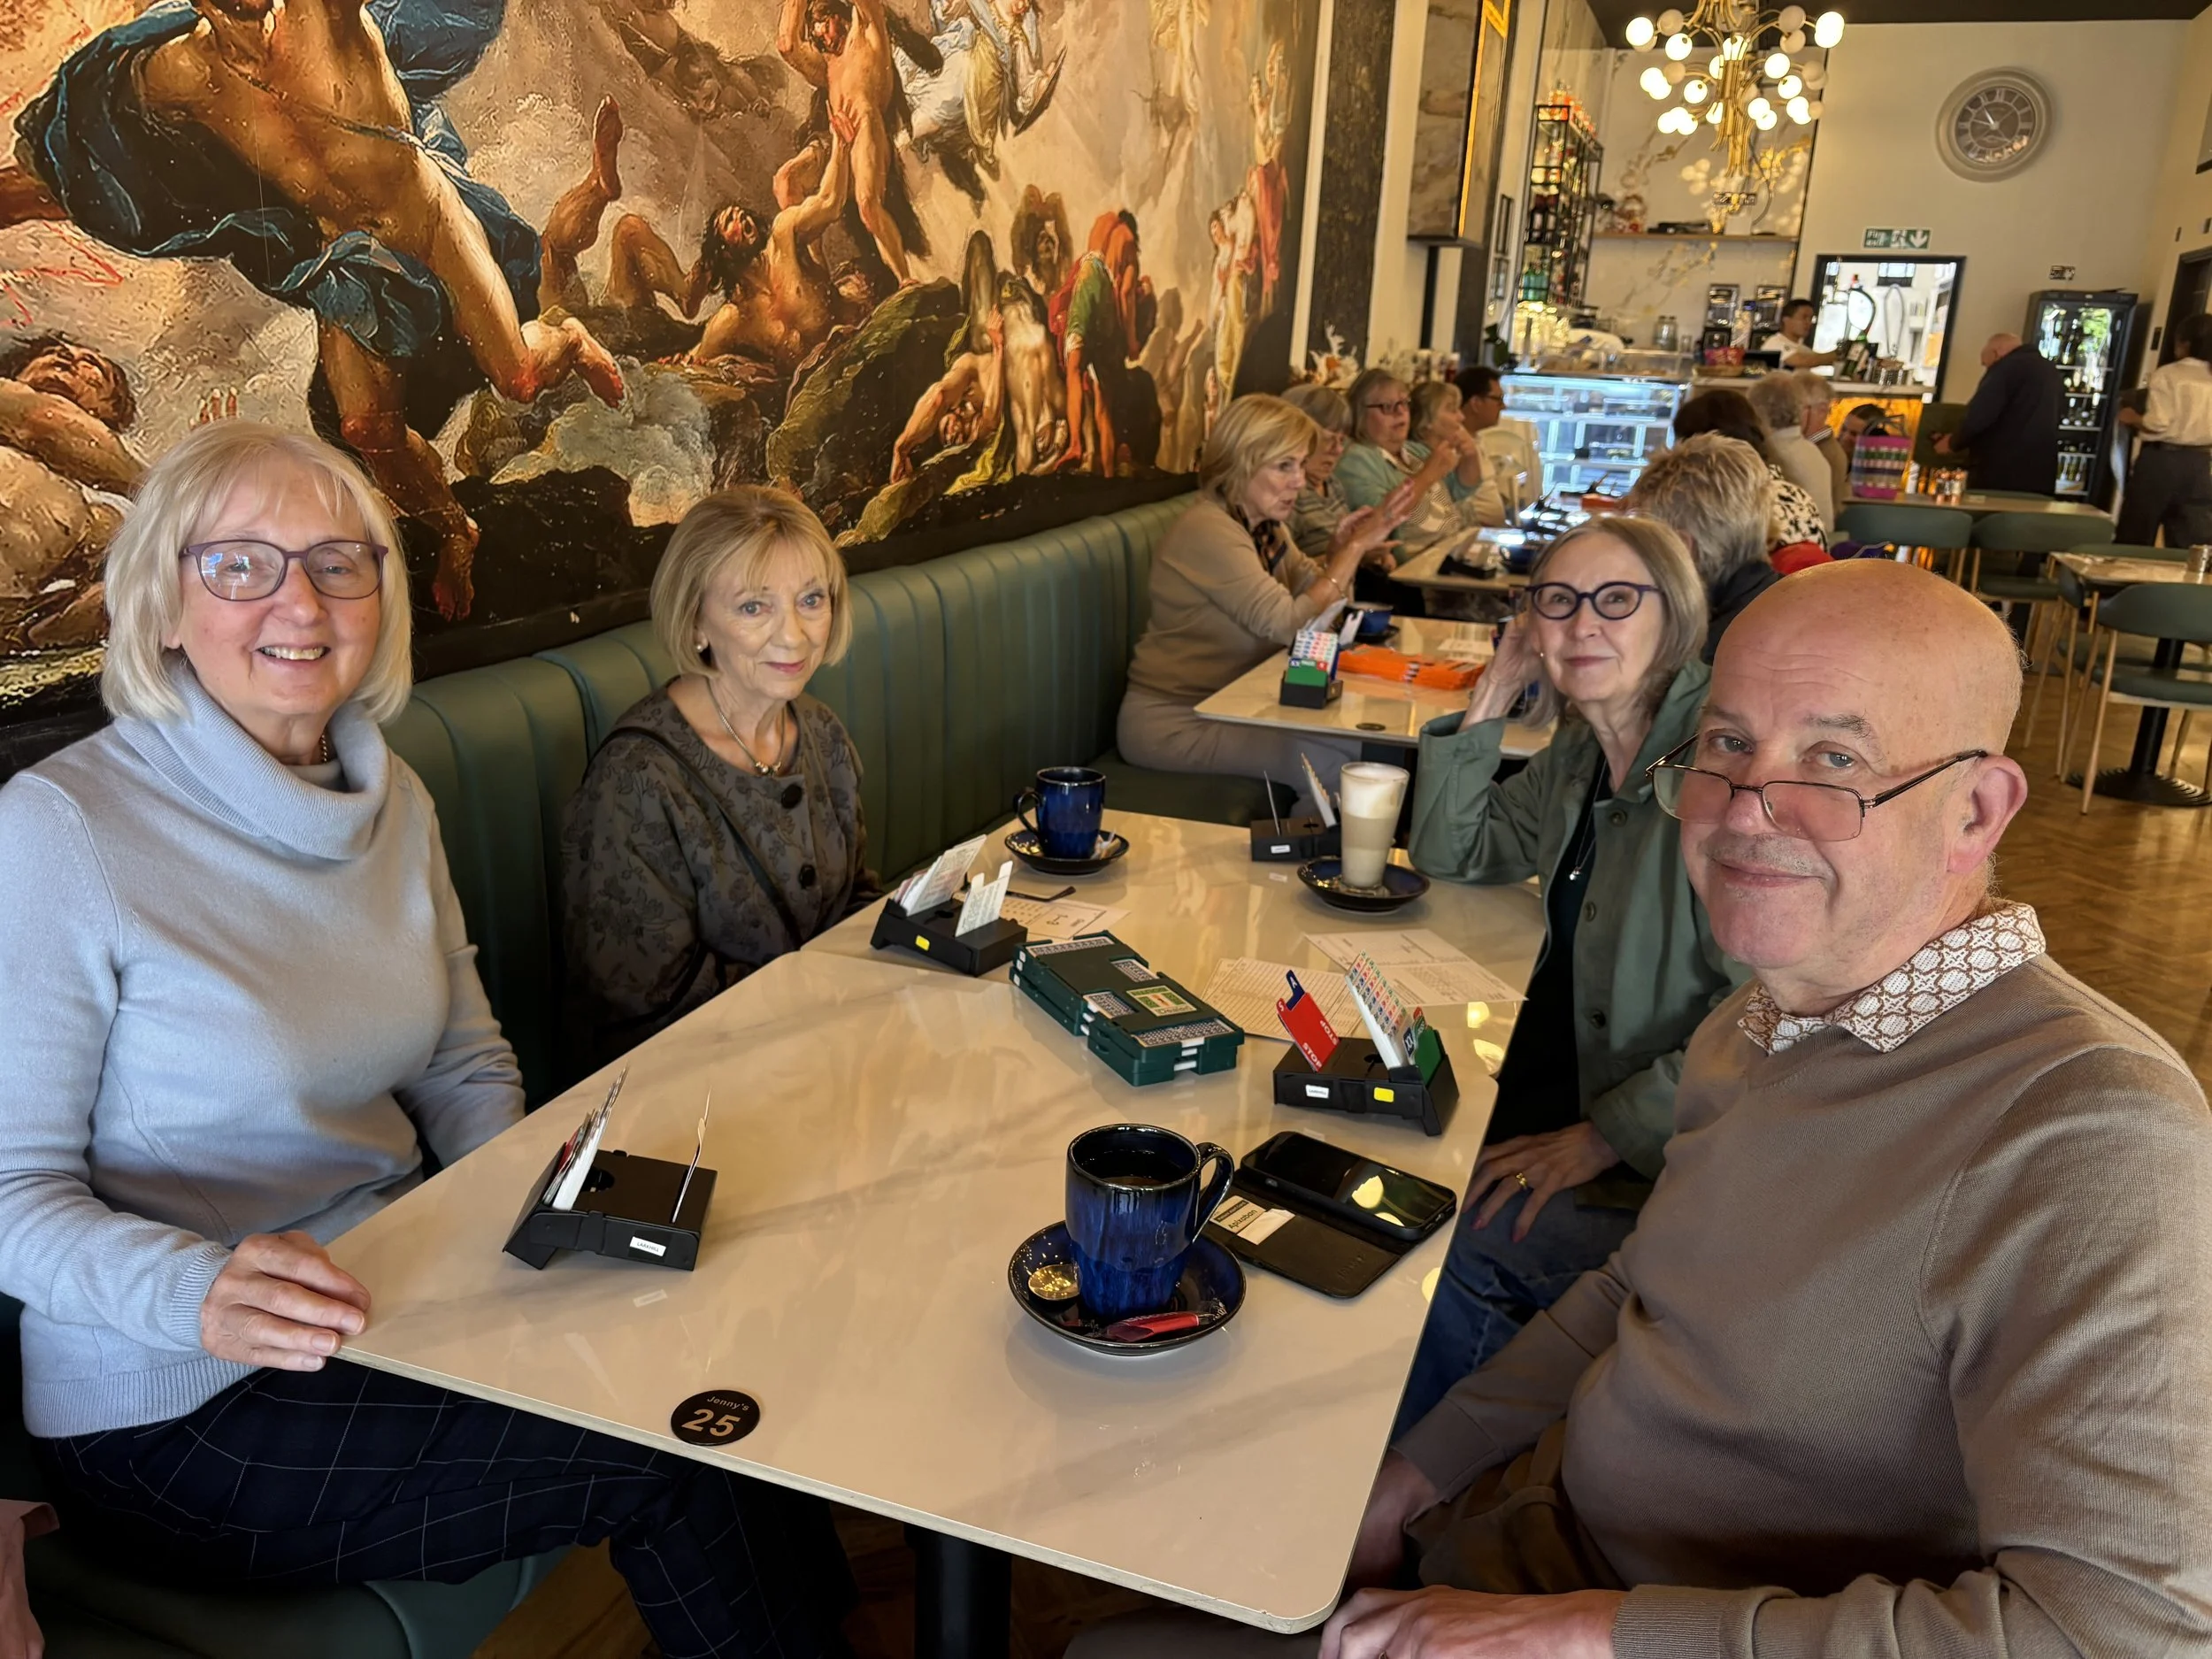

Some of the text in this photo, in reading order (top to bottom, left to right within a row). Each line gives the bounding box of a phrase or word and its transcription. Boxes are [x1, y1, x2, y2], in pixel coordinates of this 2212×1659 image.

[1319, 1019, 1340, 1047] STOP
[1302, 1042, 1323, 1069] STOP
[707, 1396, 750, 1411] Jenny's
[681, 1409, 741, 1437] 25
